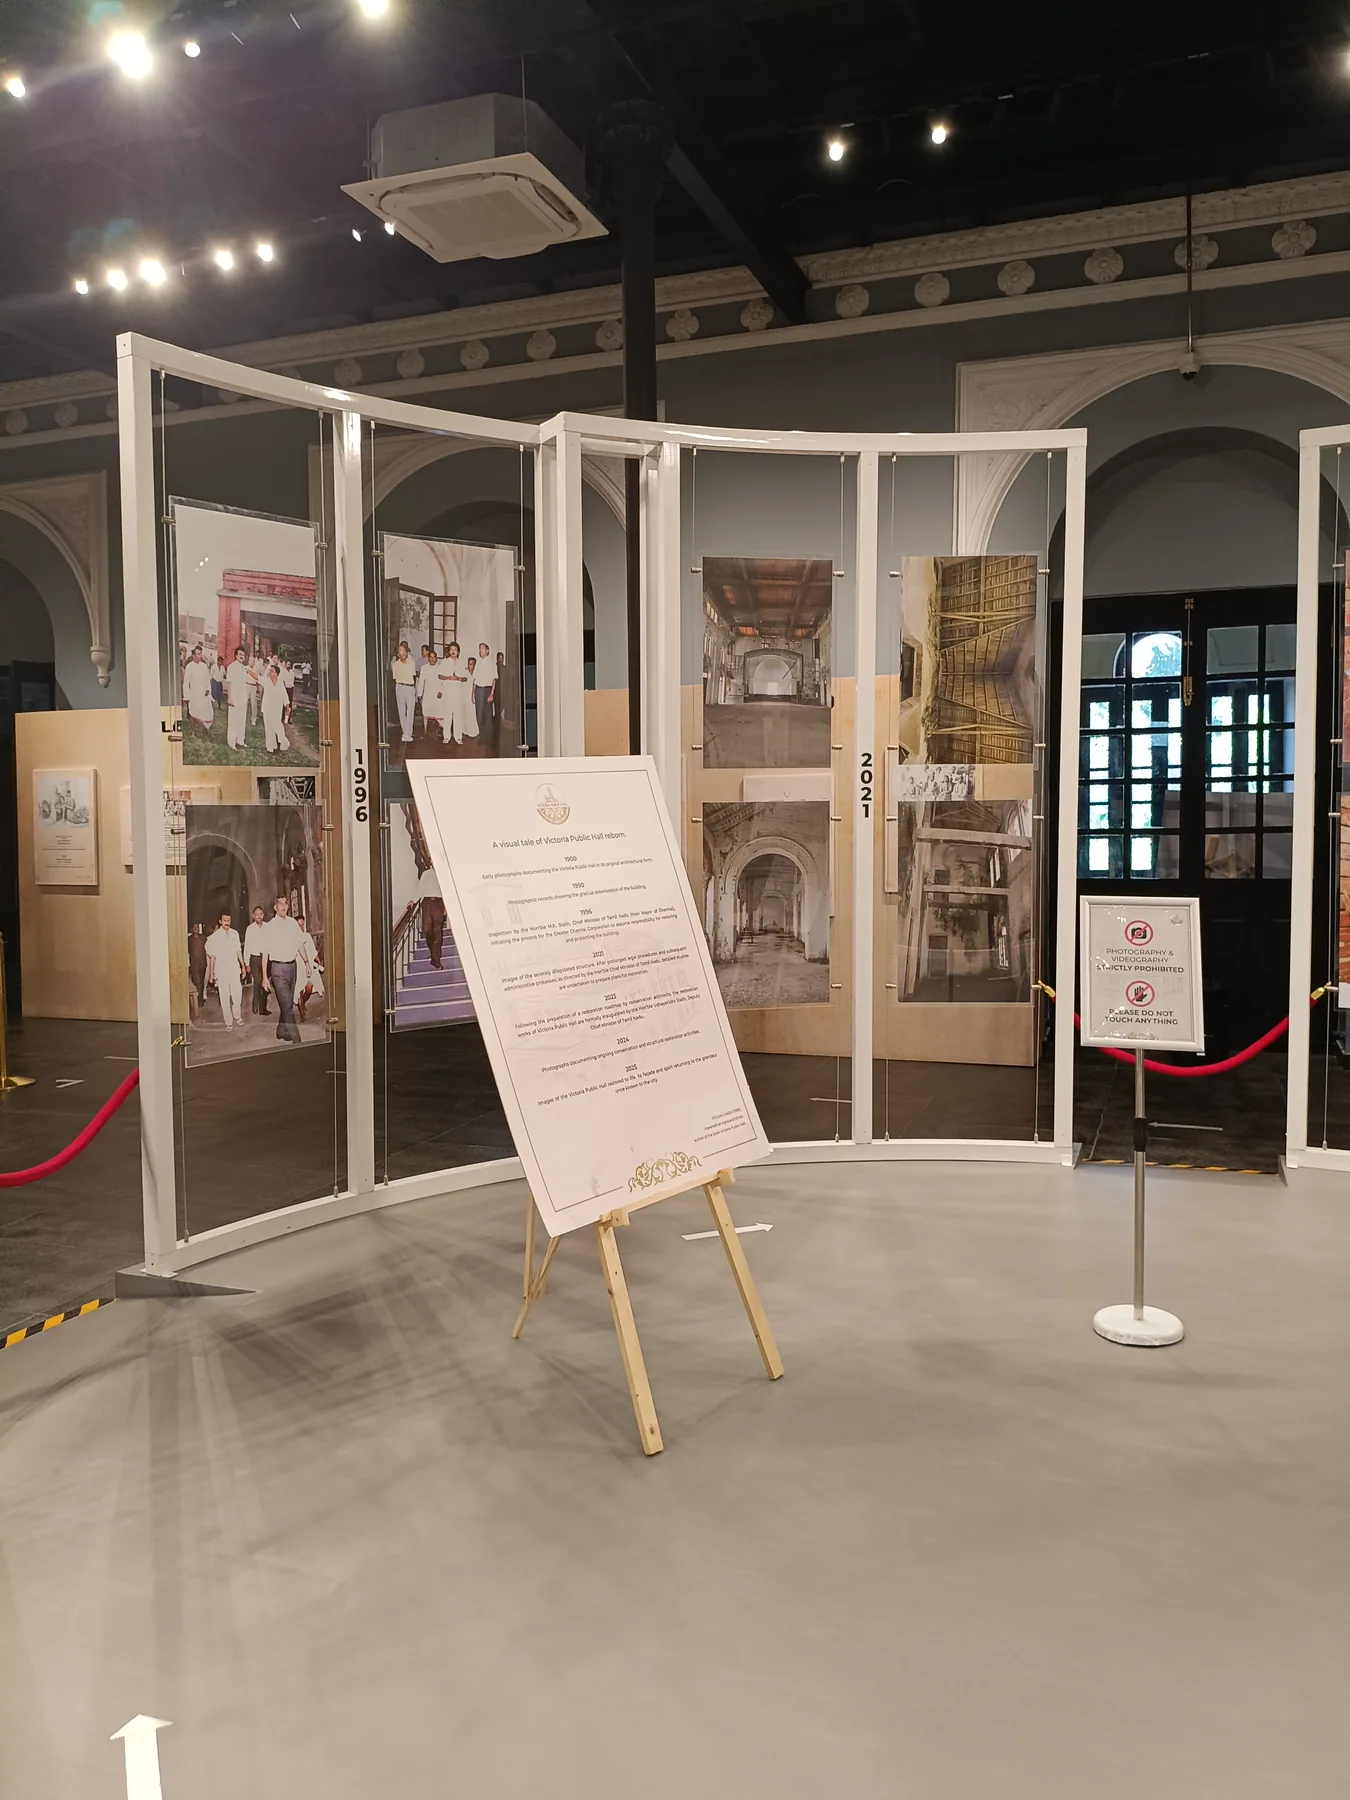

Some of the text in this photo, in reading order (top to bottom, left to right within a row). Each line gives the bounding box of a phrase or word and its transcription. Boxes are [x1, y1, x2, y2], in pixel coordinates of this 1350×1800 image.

[354, 749, 368, 822] 1996
[860, 752, 872, 818] 2021
[542, 1062, 569, 1072] Photographs
[570, 1056, 597, 1065] documenting
[614, 1045, 638, 1054] conservation
[625, 1064, 637, 1072] 2025
